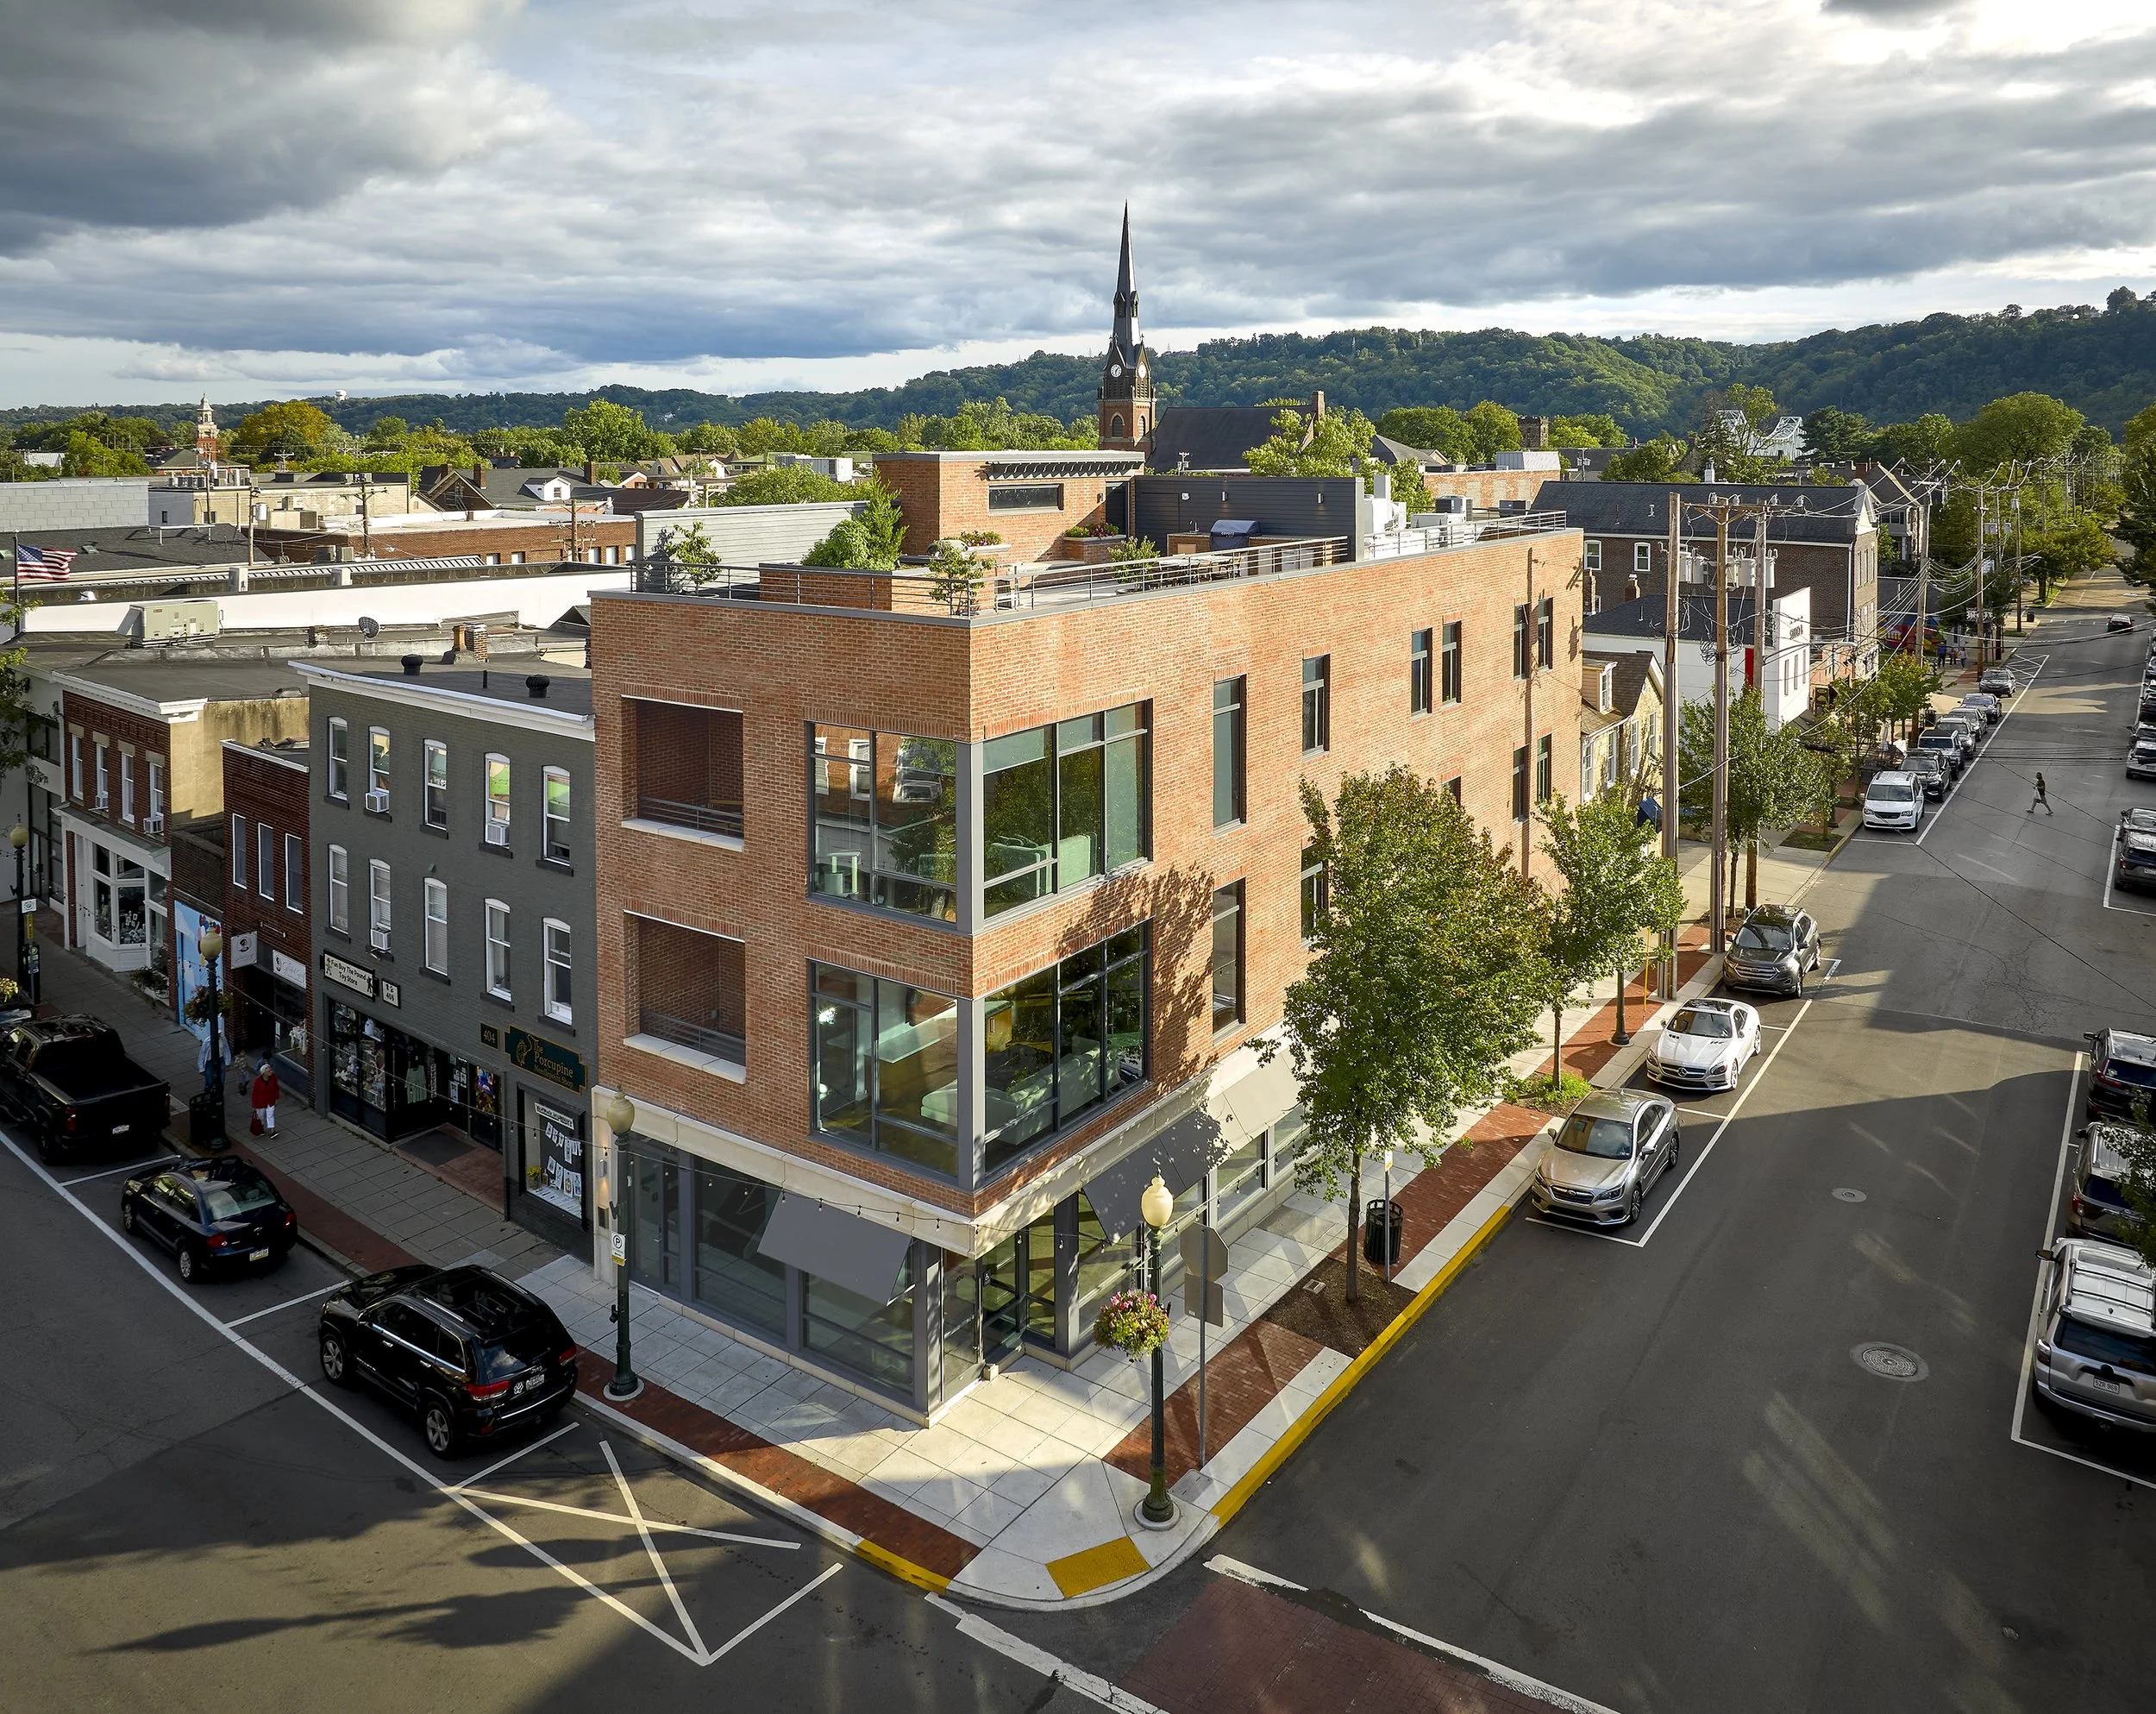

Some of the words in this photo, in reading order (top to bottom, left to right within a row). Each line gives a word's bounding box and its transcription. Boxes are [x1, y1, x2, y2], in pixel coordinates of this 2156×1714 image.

[348, 976, 358, 985] Store
[354, 970, 367, 981] Pound
[483, 1030, 495, 1044] 404
[535, 1039, 543, 1053] The
[535, 1052, 573, 1078] Porcupine
[561, 1075, 573, 1089] Shop
